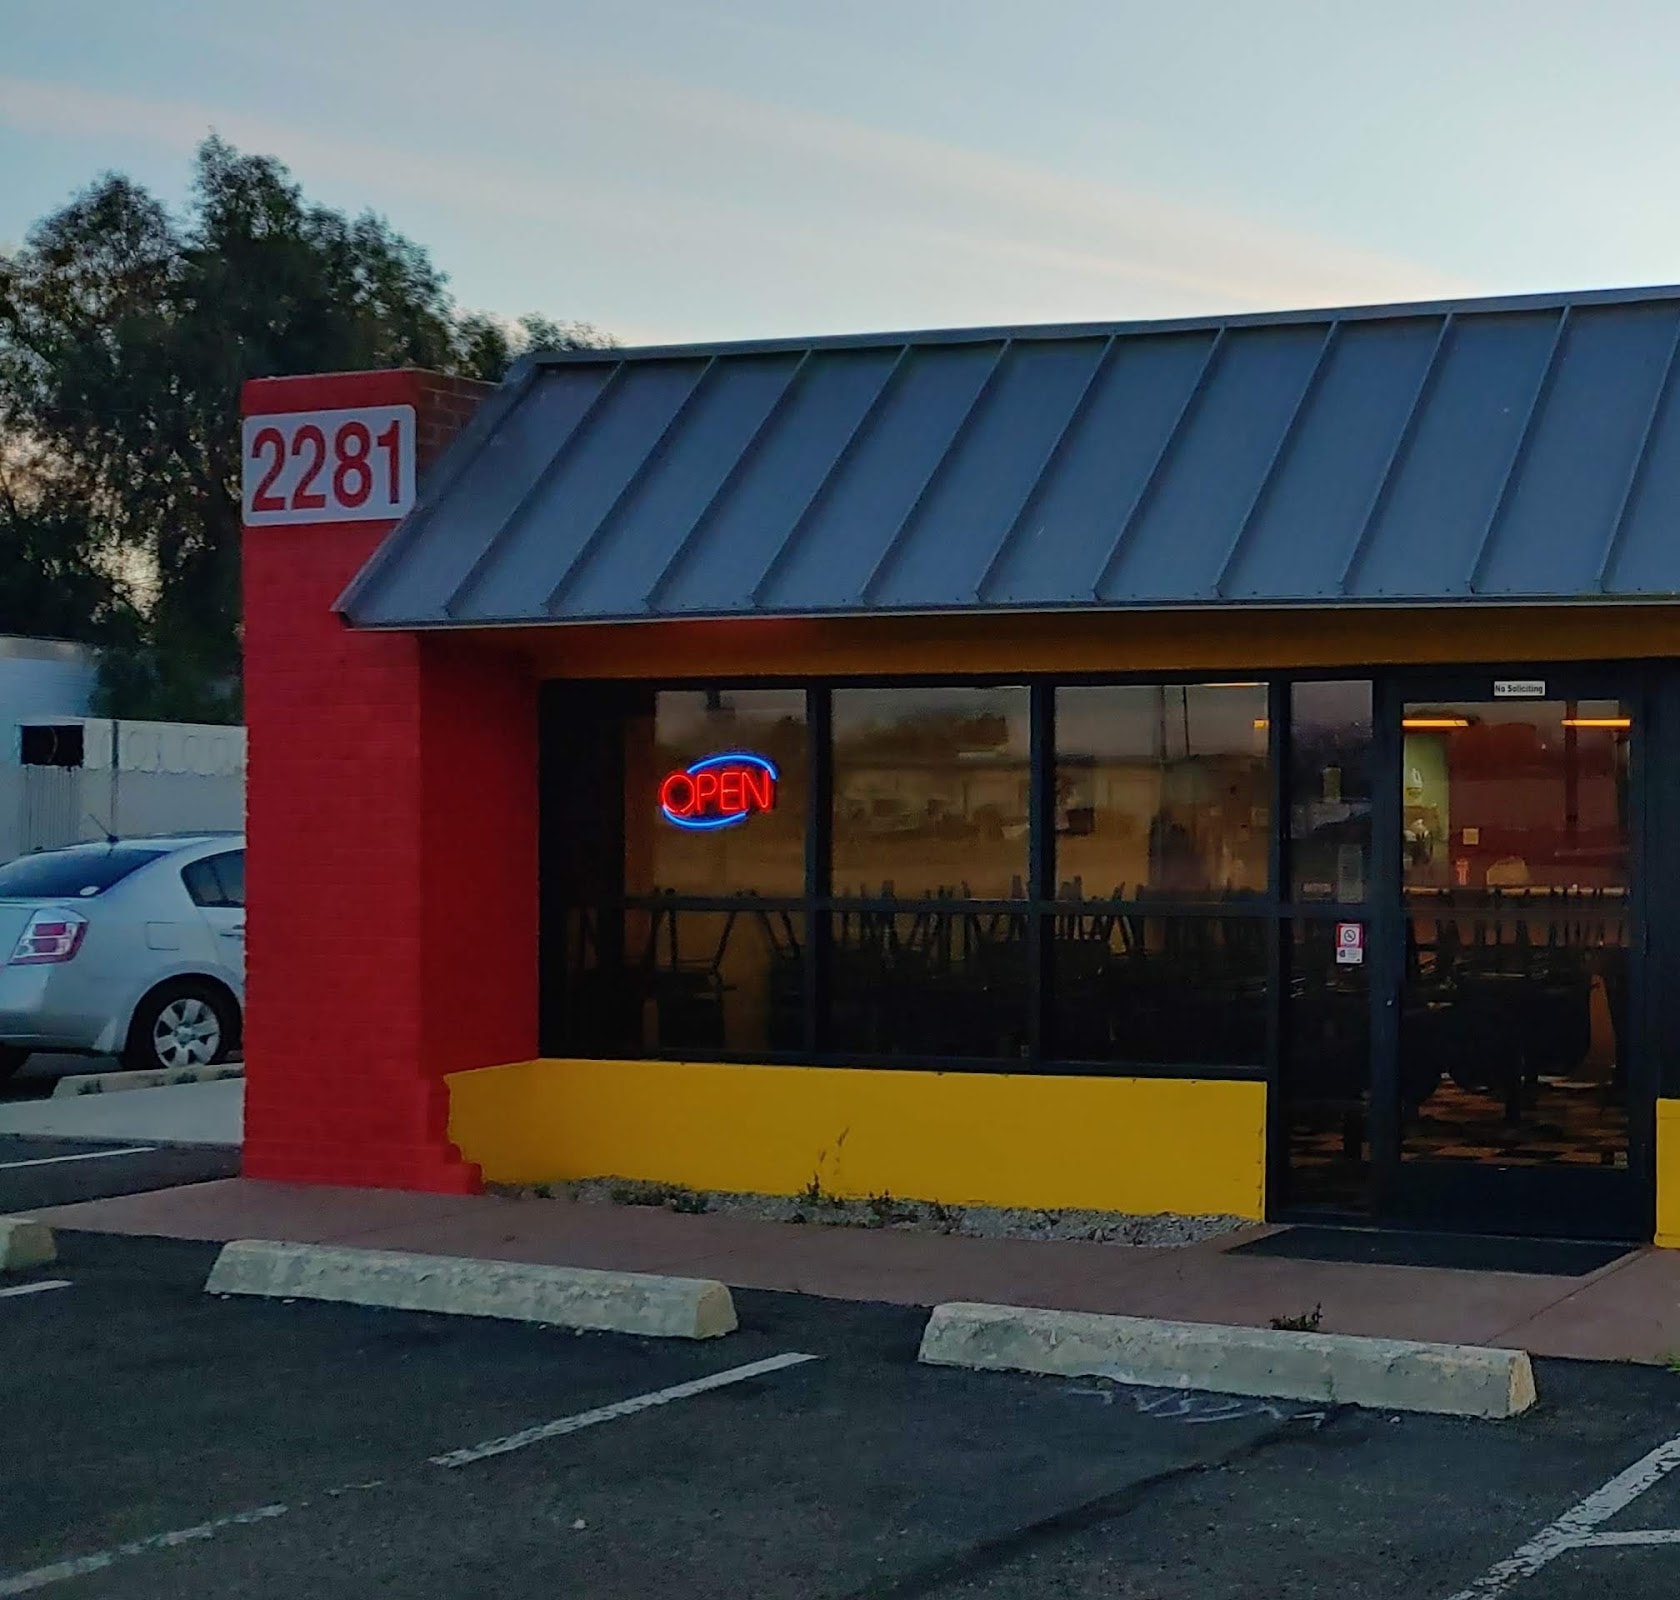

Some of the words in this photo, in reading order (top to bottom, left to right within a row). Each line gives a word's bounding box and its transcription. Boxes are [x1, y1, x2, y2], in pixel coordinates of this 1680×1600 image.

[251, 419, 400, 512] 2281
[1495, 684, 1506, 693] No
[1507, 684, 1543, 694] Soliciting
[660, 770, 771, 814] OPEN
